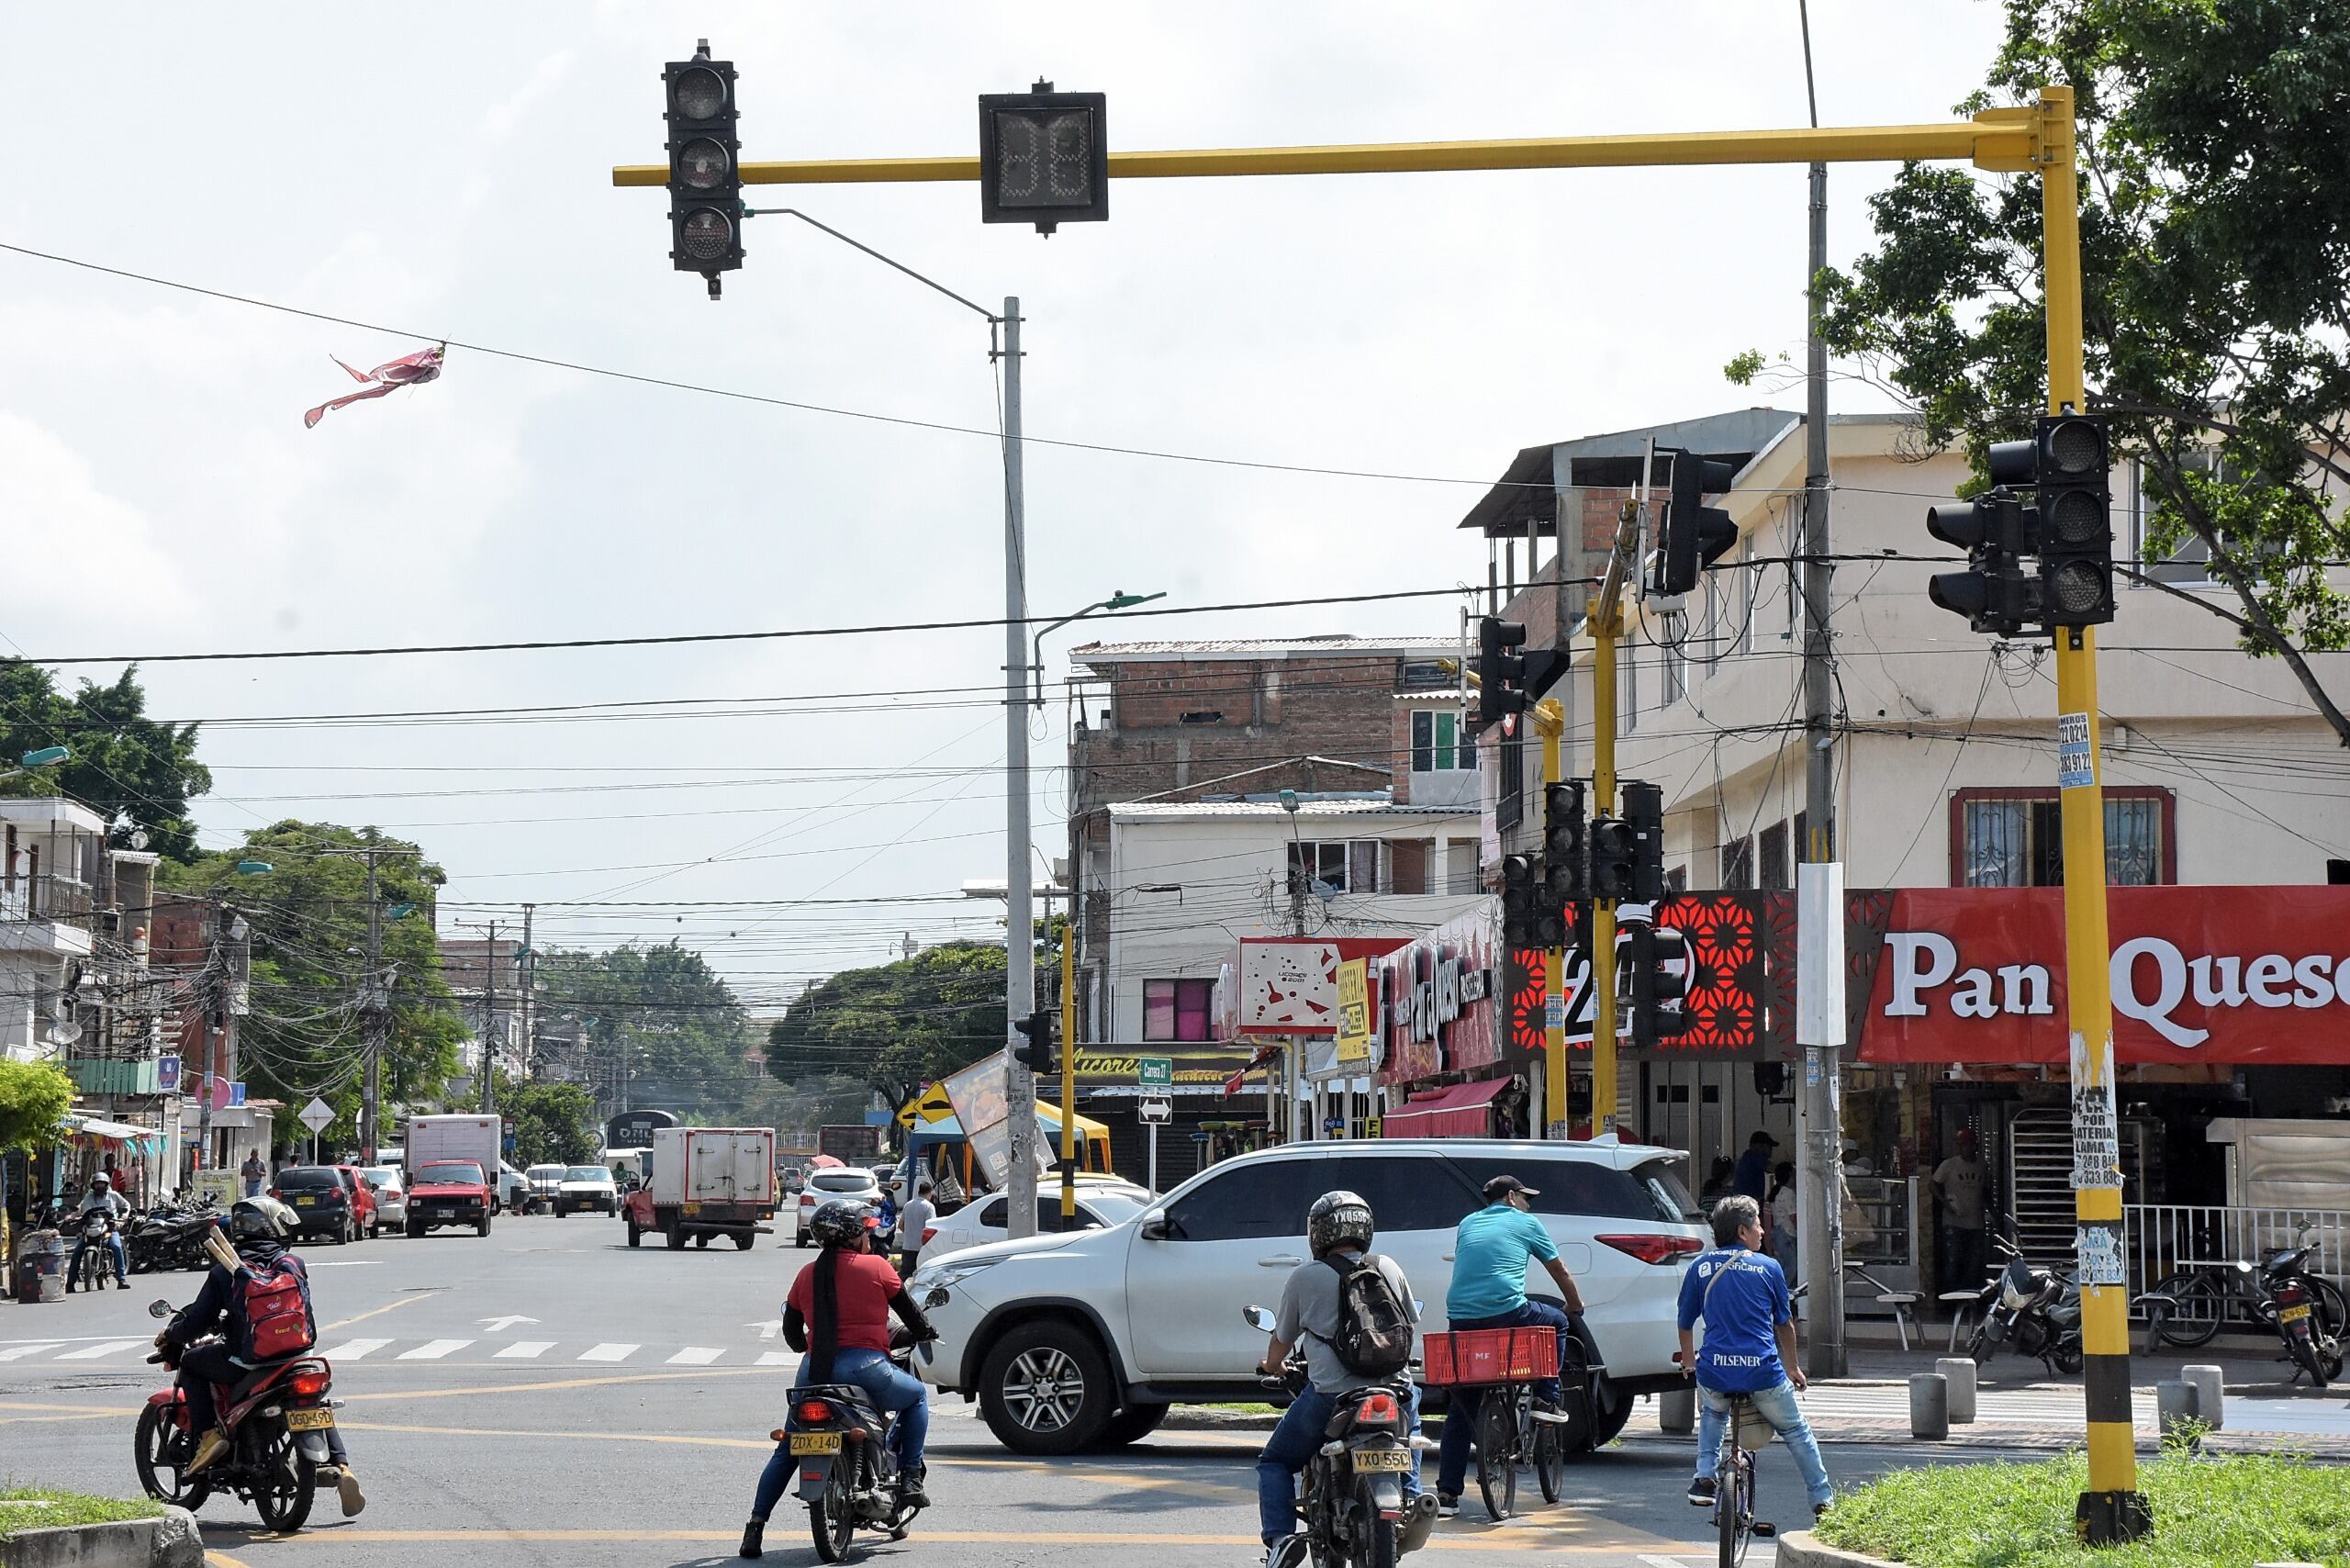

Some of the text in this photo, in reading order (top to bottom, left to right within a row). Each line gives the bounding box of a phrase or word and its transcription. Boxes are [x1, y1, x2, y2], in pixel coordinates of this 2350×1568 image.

[2059, 715, 2087, 726] MEROS
[1885, 932, 2053, 1019] Pan
[2083, 1114, 2106, 1126] POR
[1715, 1261, 1763, 1273] PcifiCard
[1713, 1353, 1761, 1367] PILSENER
[791, 1436, 839, 1450] ZDX 14D
